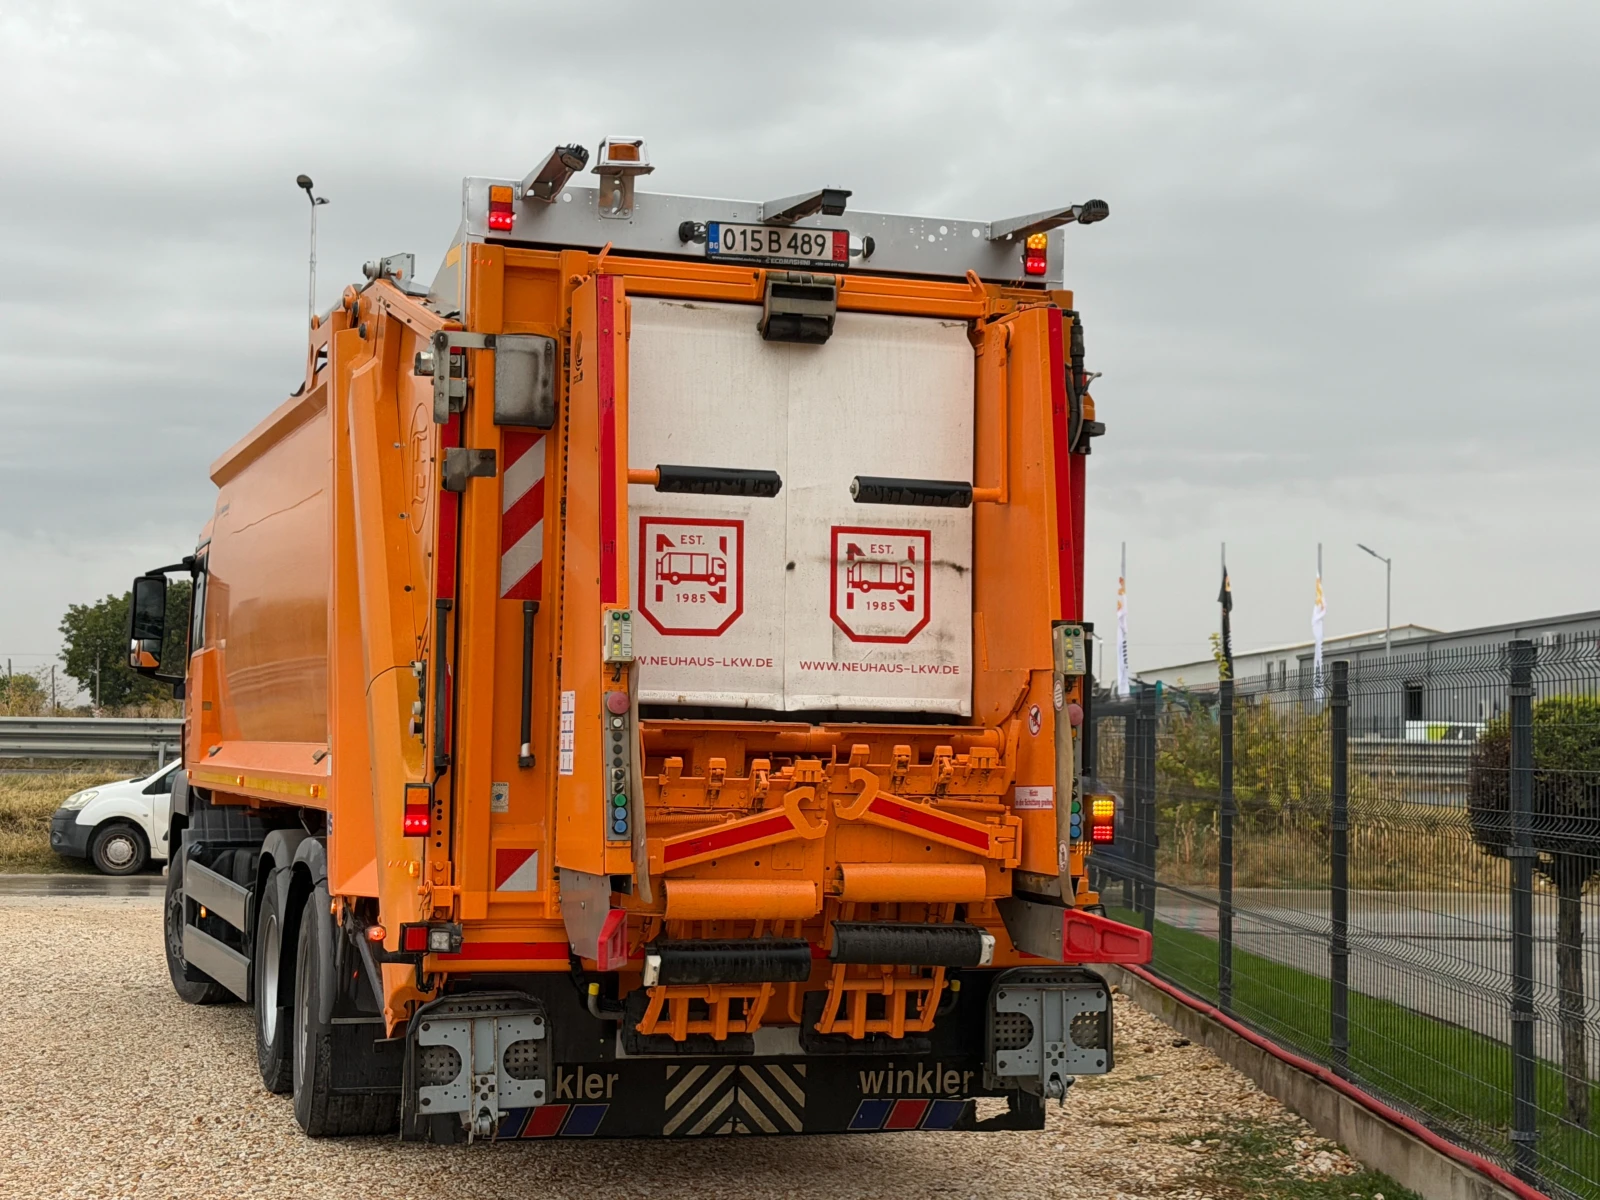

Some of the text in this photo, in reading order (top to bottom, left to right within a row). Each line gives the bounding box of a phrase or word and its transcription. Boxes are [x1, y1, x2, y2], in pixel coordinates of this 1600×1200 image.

[680, 534, 705, 545] EST.
[870, 544, 894, 554] EST.
[676, 593, 706, 603] 1985
[866, 601, 896, 611] 1985
[633, 655, 774, 668] W.NEUHAUS-LKW.DE
[799, 661, 960, 675] WWW.NEUHAUS-LKW.DE
[555, 1066, 619, 1099] kler
[859, 1062, 974, 1094] winkler
